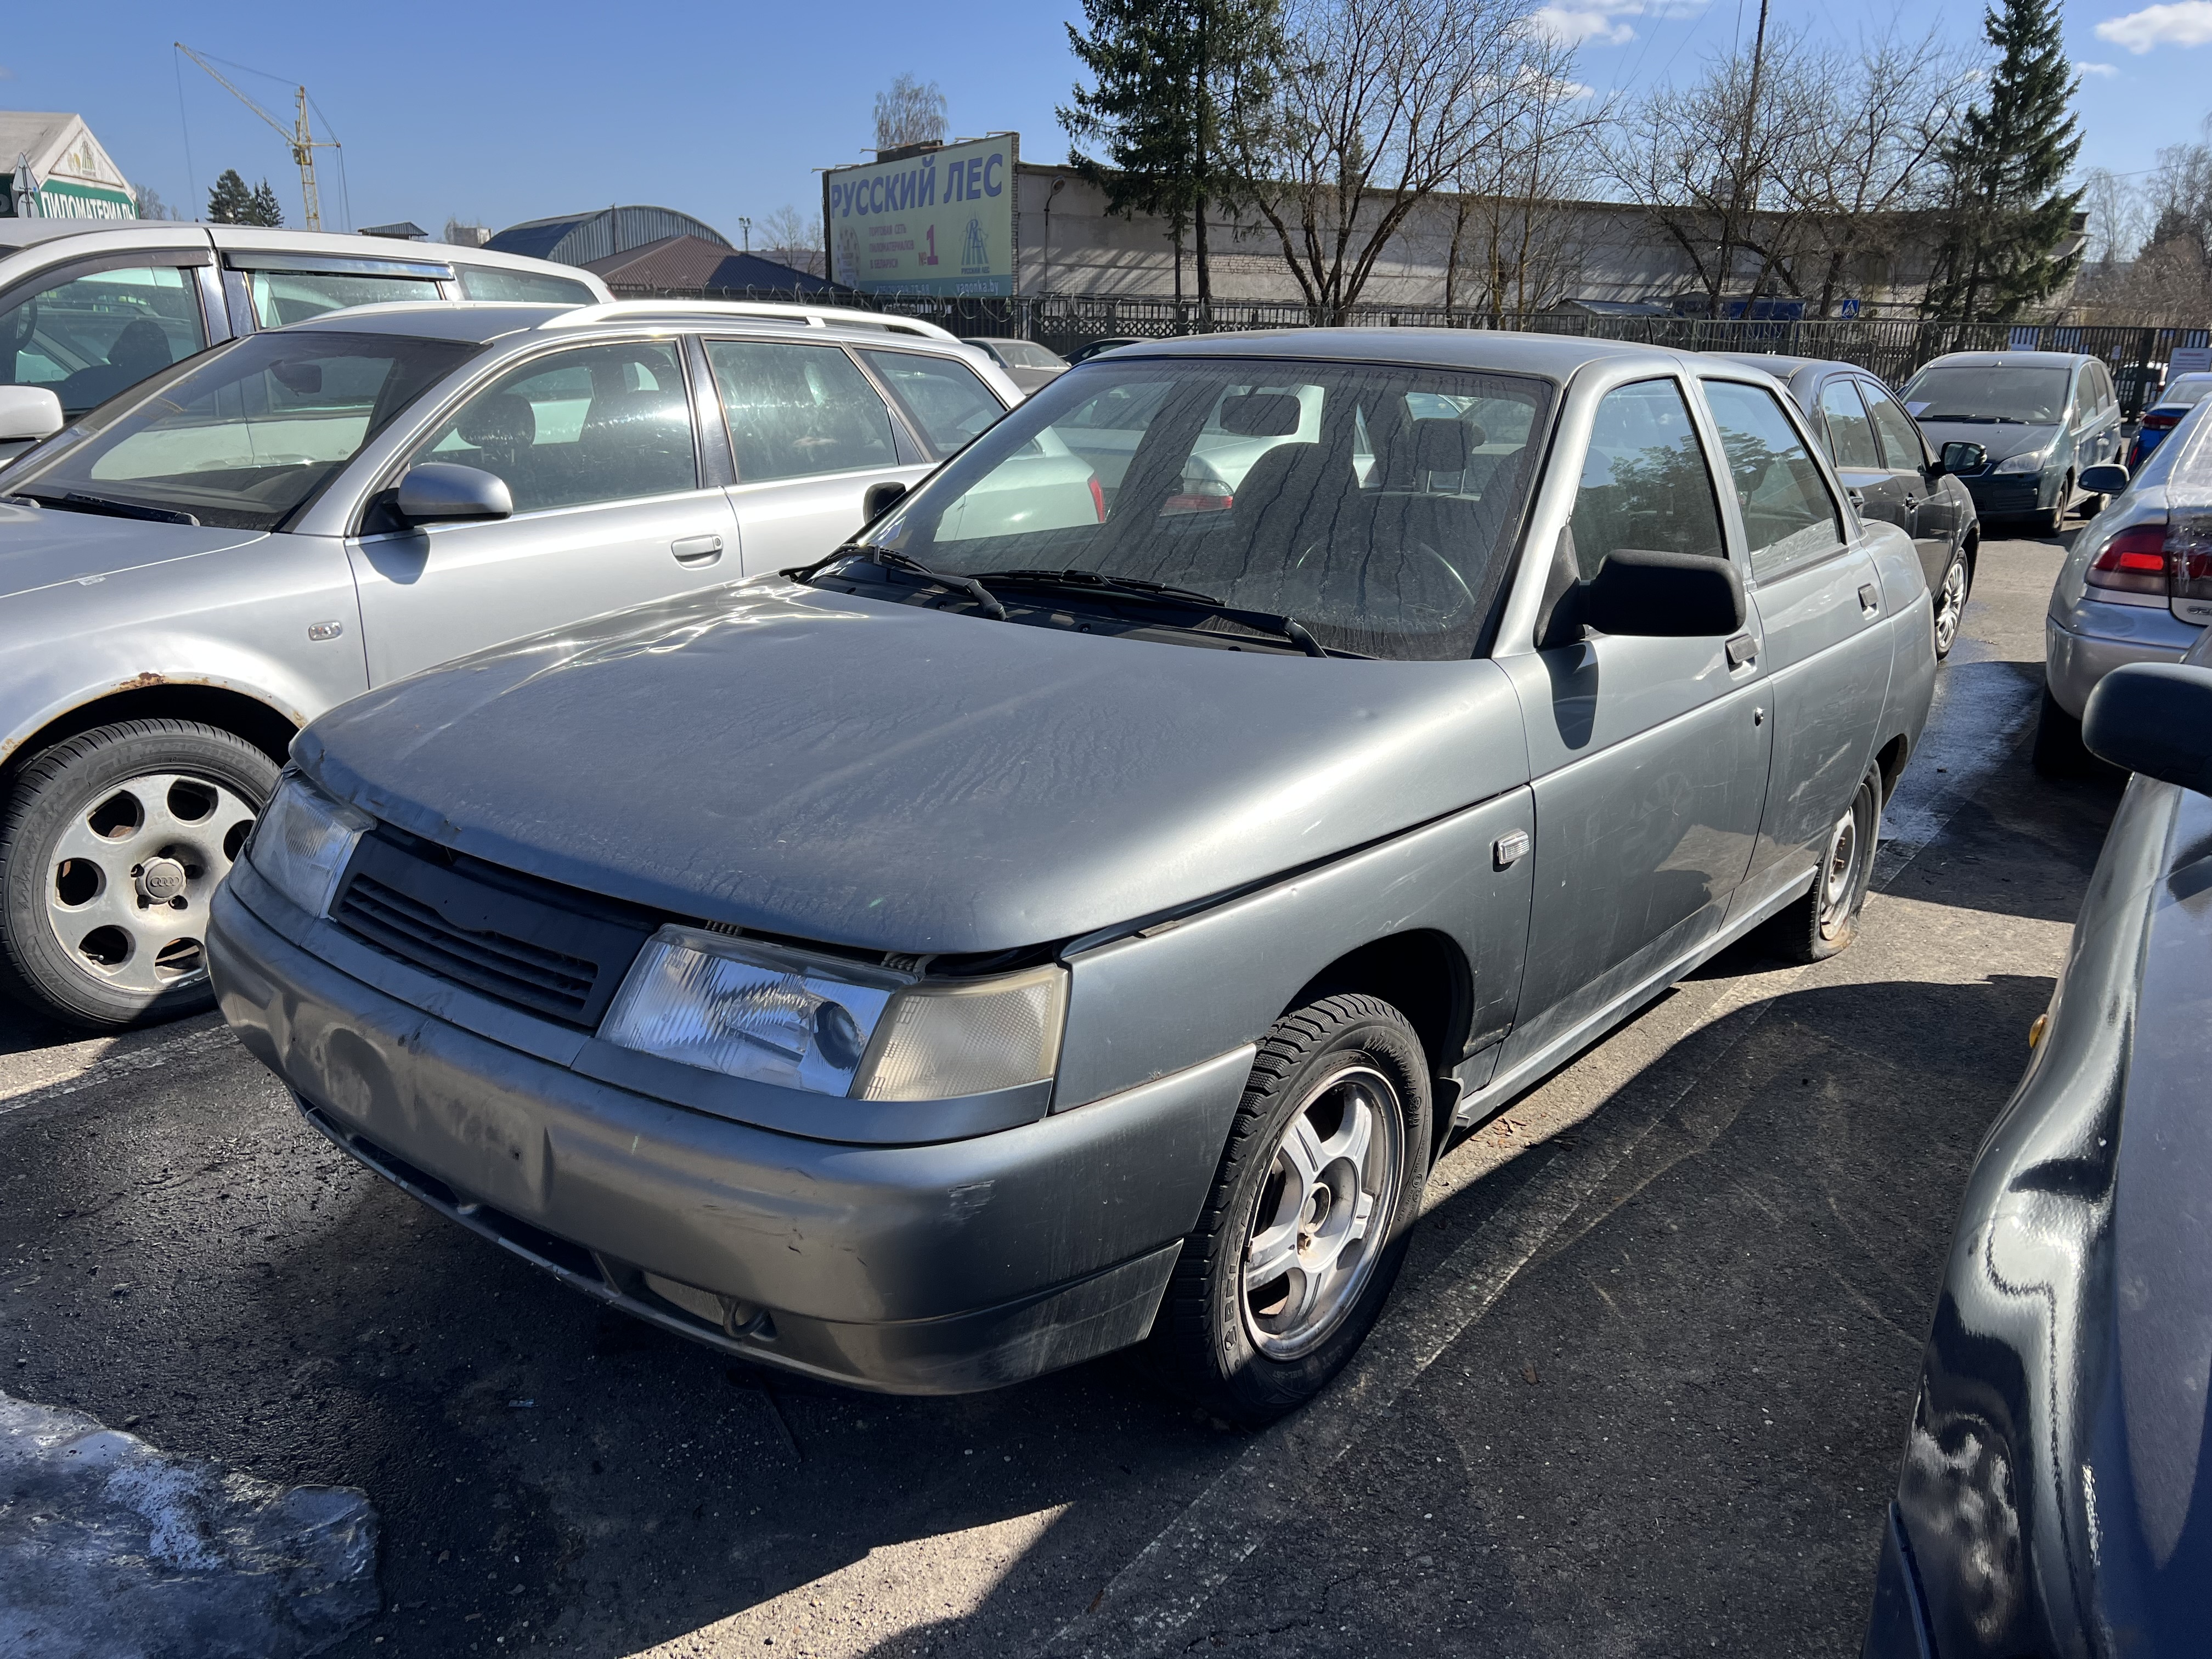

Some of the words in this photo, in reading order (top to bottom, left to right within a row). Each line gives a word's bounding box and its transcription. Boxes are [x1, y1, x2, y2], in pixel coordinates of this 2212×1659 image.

[831, 155, 935, 219] РУССКИЙ
[943, 154, 1003, 204] ЛЕС
[955, 278, 1000, 296] vagonka.by
